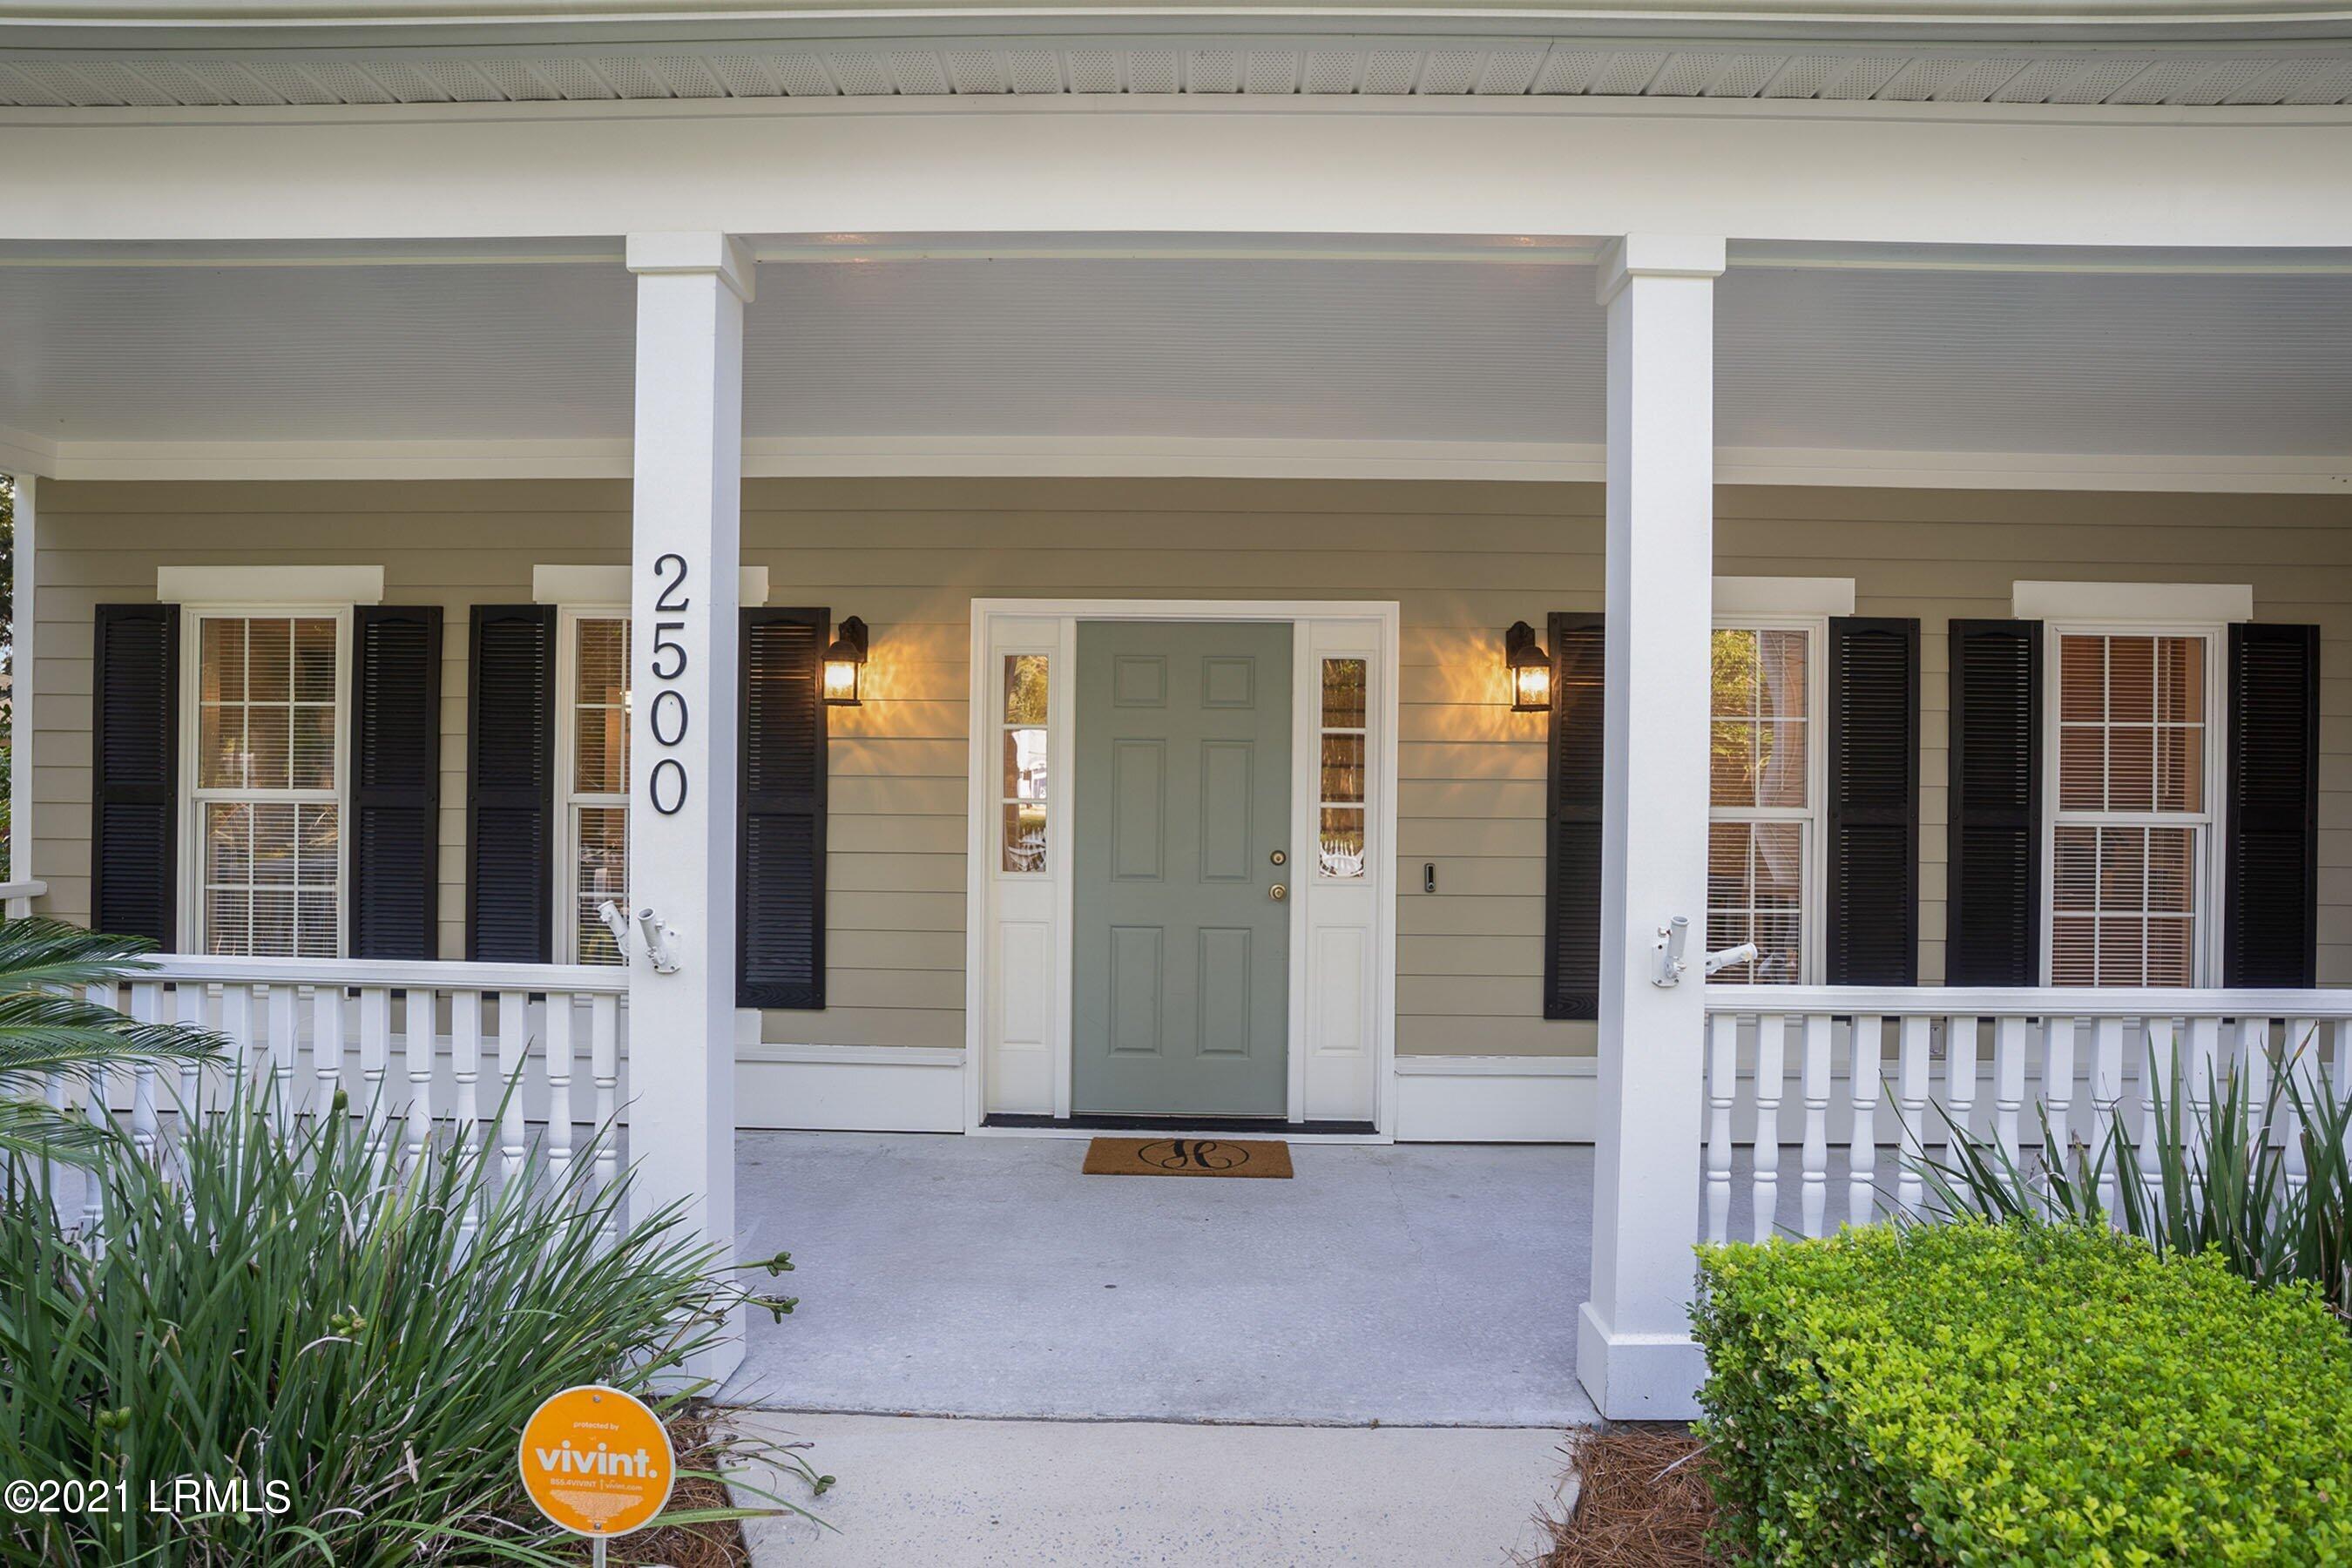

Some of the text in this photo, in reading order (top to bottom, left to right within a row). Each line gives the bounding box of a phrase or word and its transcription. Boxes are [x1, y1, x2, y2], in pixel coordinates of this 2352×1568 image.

[650, 553, 690, 815] 2500
[610, 1423, 619, 1431] by
[535, 1440, 658, 1478] vivint.
[605, 1482, 643, 1490] vivint.com
